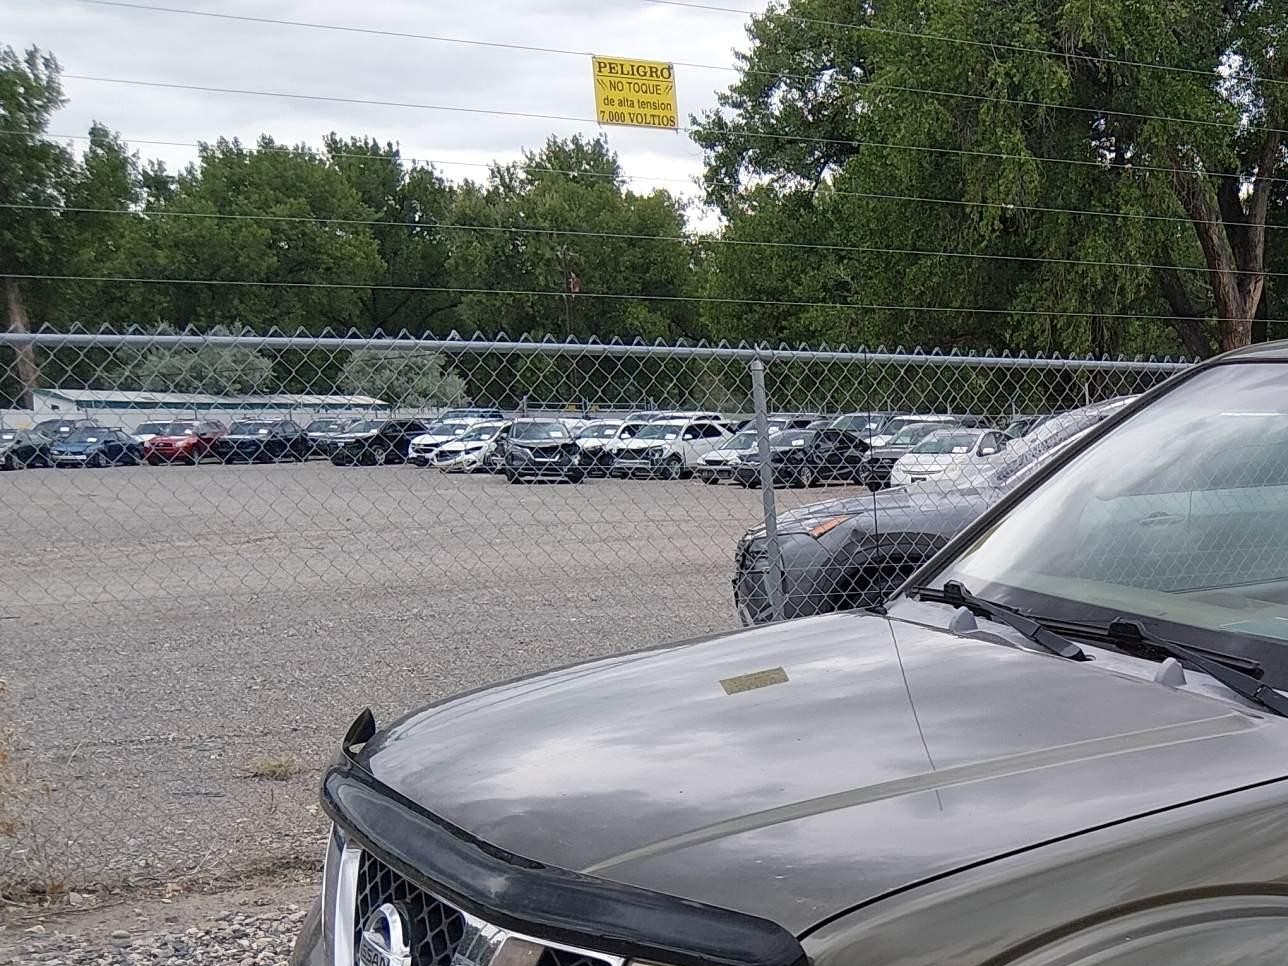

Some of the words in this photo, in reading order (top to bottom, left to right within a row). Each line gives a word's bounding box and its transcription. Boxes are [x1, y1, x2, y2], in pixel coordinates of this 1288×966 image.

[597, 61, 672, 79] PELIGRO
[609, 80, 624, 92] NO
[627, 82, 661, 95] TOQUE
[603, 96, 615, 106] de
[617, 97, 635, 108] alta
[637, 99, 672, 111] tension
[628, 112, 676, 127] VOLTIOS
